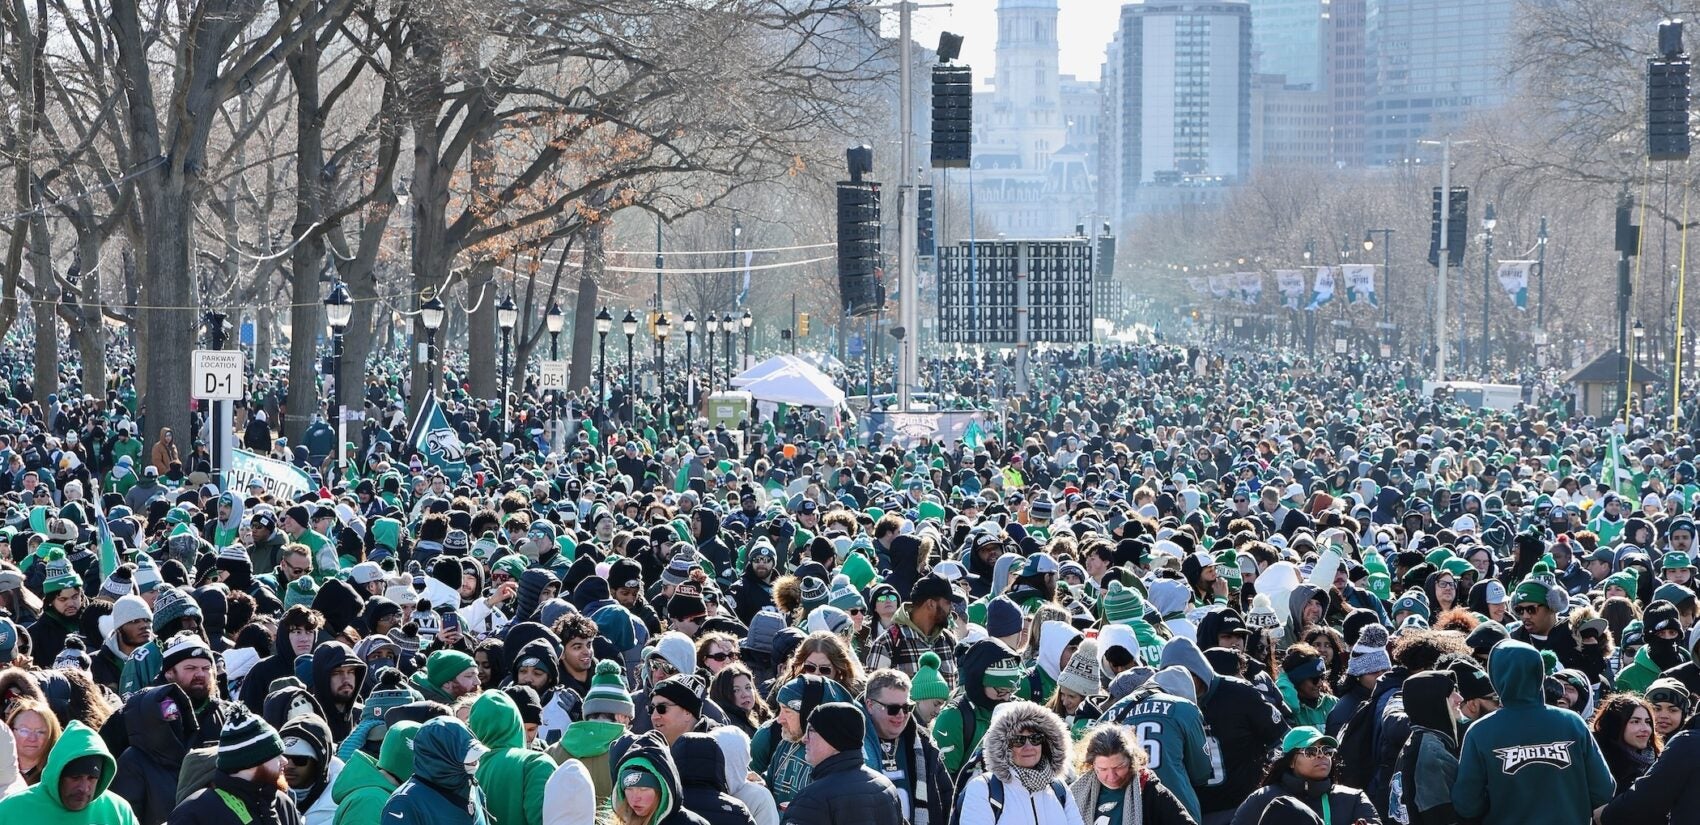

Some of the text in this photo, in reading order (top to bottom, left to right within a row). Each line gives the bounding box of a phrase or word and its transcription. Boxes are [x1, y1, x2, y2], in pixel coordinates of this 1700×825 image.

[205, 373, 231, 394] D-1
[543, 374, 564, 386] DE-1
[1136, 721, 1161, 769] 6
[1498, 743, 1573, 772] EAGLES
